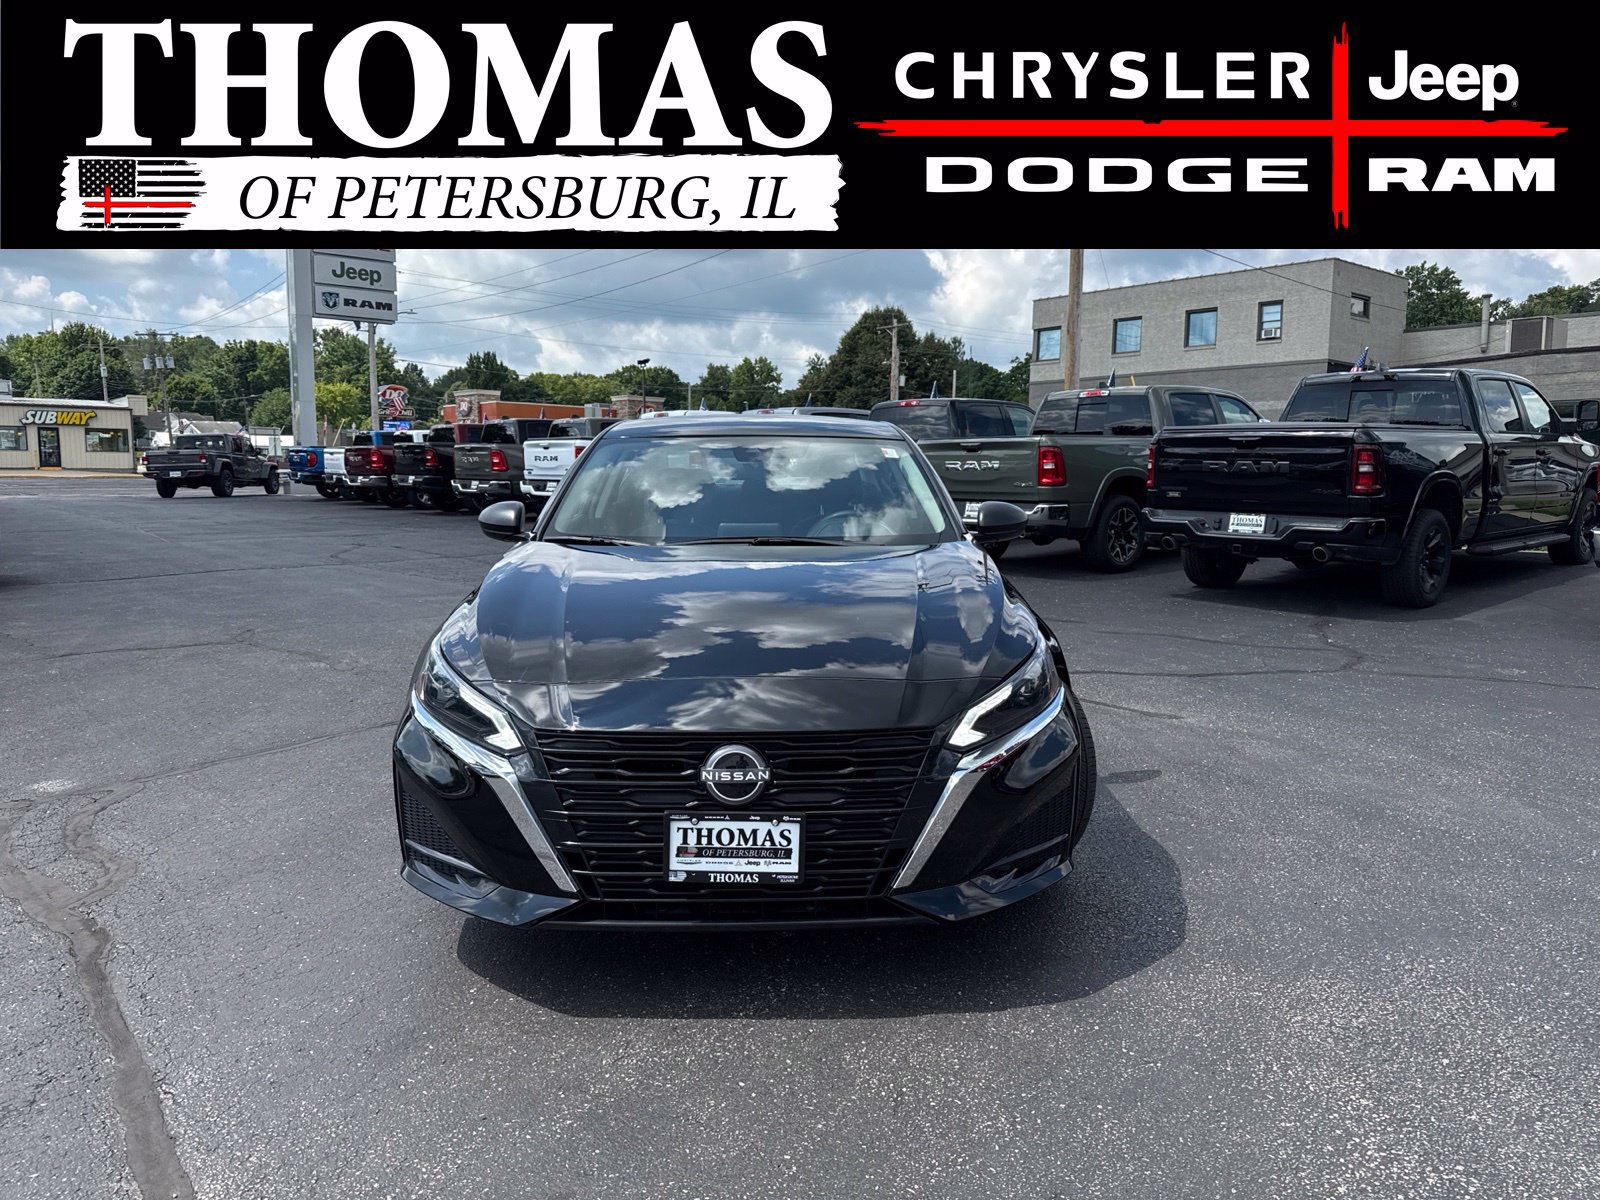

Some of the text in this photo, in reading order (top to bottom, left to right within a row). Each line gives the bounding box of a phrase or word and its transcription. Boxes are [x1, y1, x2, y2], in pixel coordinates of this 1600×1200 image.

[331, 261, 382, 286] Jeep
[343, 298, 393, 311] RAM
[20, 410, 97, 425] SUBWAY
[944, 460, 1000, 471] RAM
[1202, 460, 1290, 473] RAM
[1233, 516, 1263, 525] THOMAS
[702, 770, 769, 781] NISSAN
[676, 826, 792, 848] THOMAS
[702, 848, 786, 858] OF PETERSBURG, IL
[744, 859, 761, 867] Jeep
[708, 872, 759, 883] THOMAS
